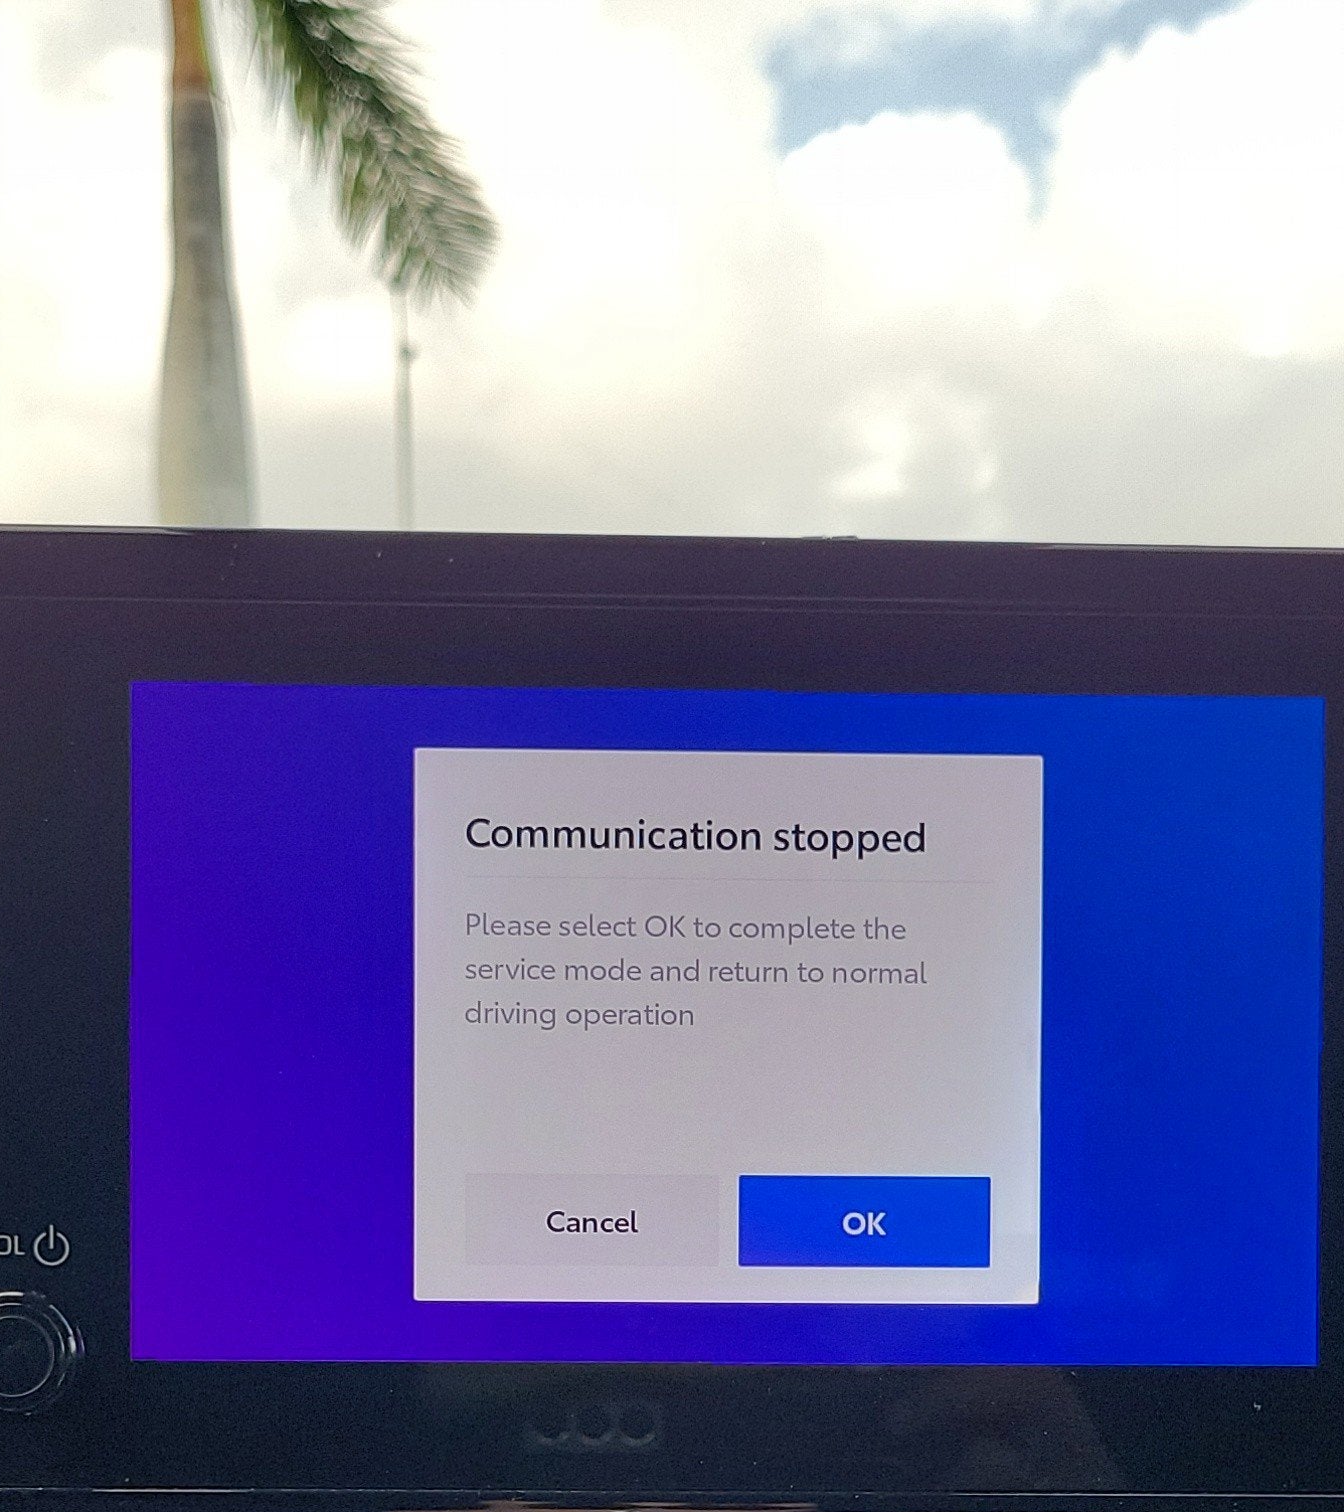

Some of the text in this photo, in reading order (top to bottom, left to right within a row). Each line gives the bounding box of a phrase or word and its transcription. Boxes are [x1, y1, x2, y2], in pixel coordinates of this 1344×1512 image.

[465, 816, 928, 861] Communication stopped
[465, 911, 908, 947] Please select OK to complete the
[464, 959, 928, 986] service mode and return to normal
[464, 1001, 695, 1032] driving operation
[545, 1210, 639, 1235] Cancel
[841, 1211, 887, 1237] OK
